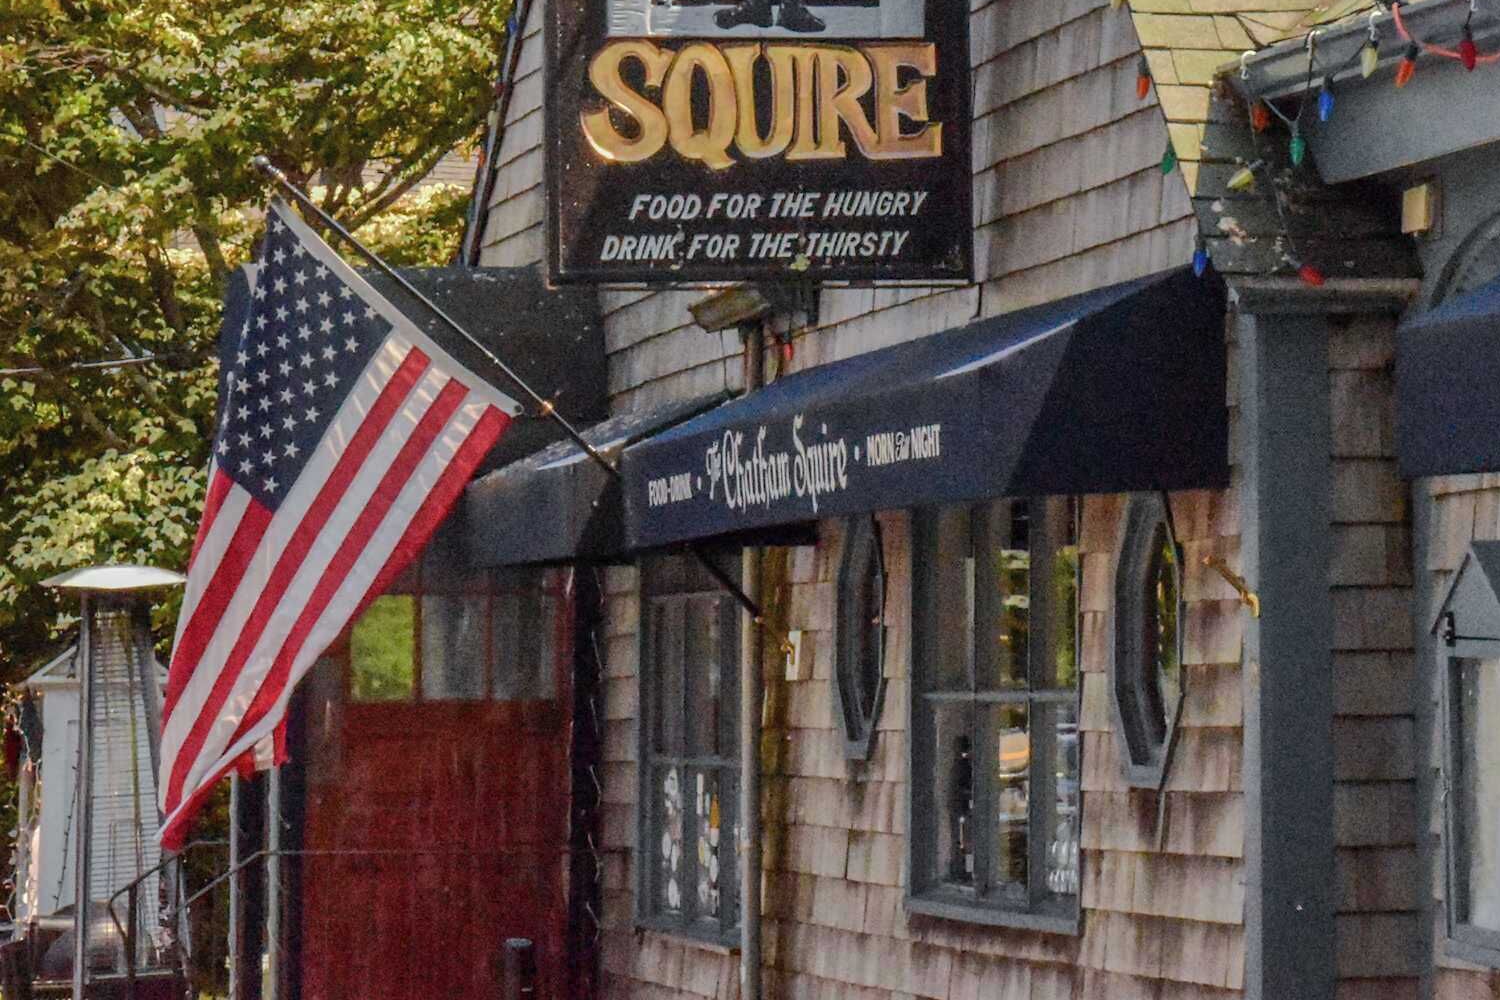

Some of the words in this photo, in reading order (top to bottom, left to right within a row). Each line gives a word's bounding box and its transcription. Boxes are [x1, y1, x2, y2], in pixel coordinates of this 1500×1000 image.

[580, 39, 943, 170] SQUIRE
[629, 194, 701, 220] FOOD
[707, 193, 764, 218] FOR
[768, 191, 820, 217] THE
[822, 190, 928, 216] HUNGRY
[601, 233, 679, 261] DRINK
[686, 233, 740, 259] FOR
[748, 232, 798, 258] THE
[805, 230, 910, 257] THIRSTY
[722, 425, 791, 514] Chatham
[793, 413, 847, 514] Squire
[867, 432, 895, 467] MORN
[911, 424, 941, 459] NIGHT
